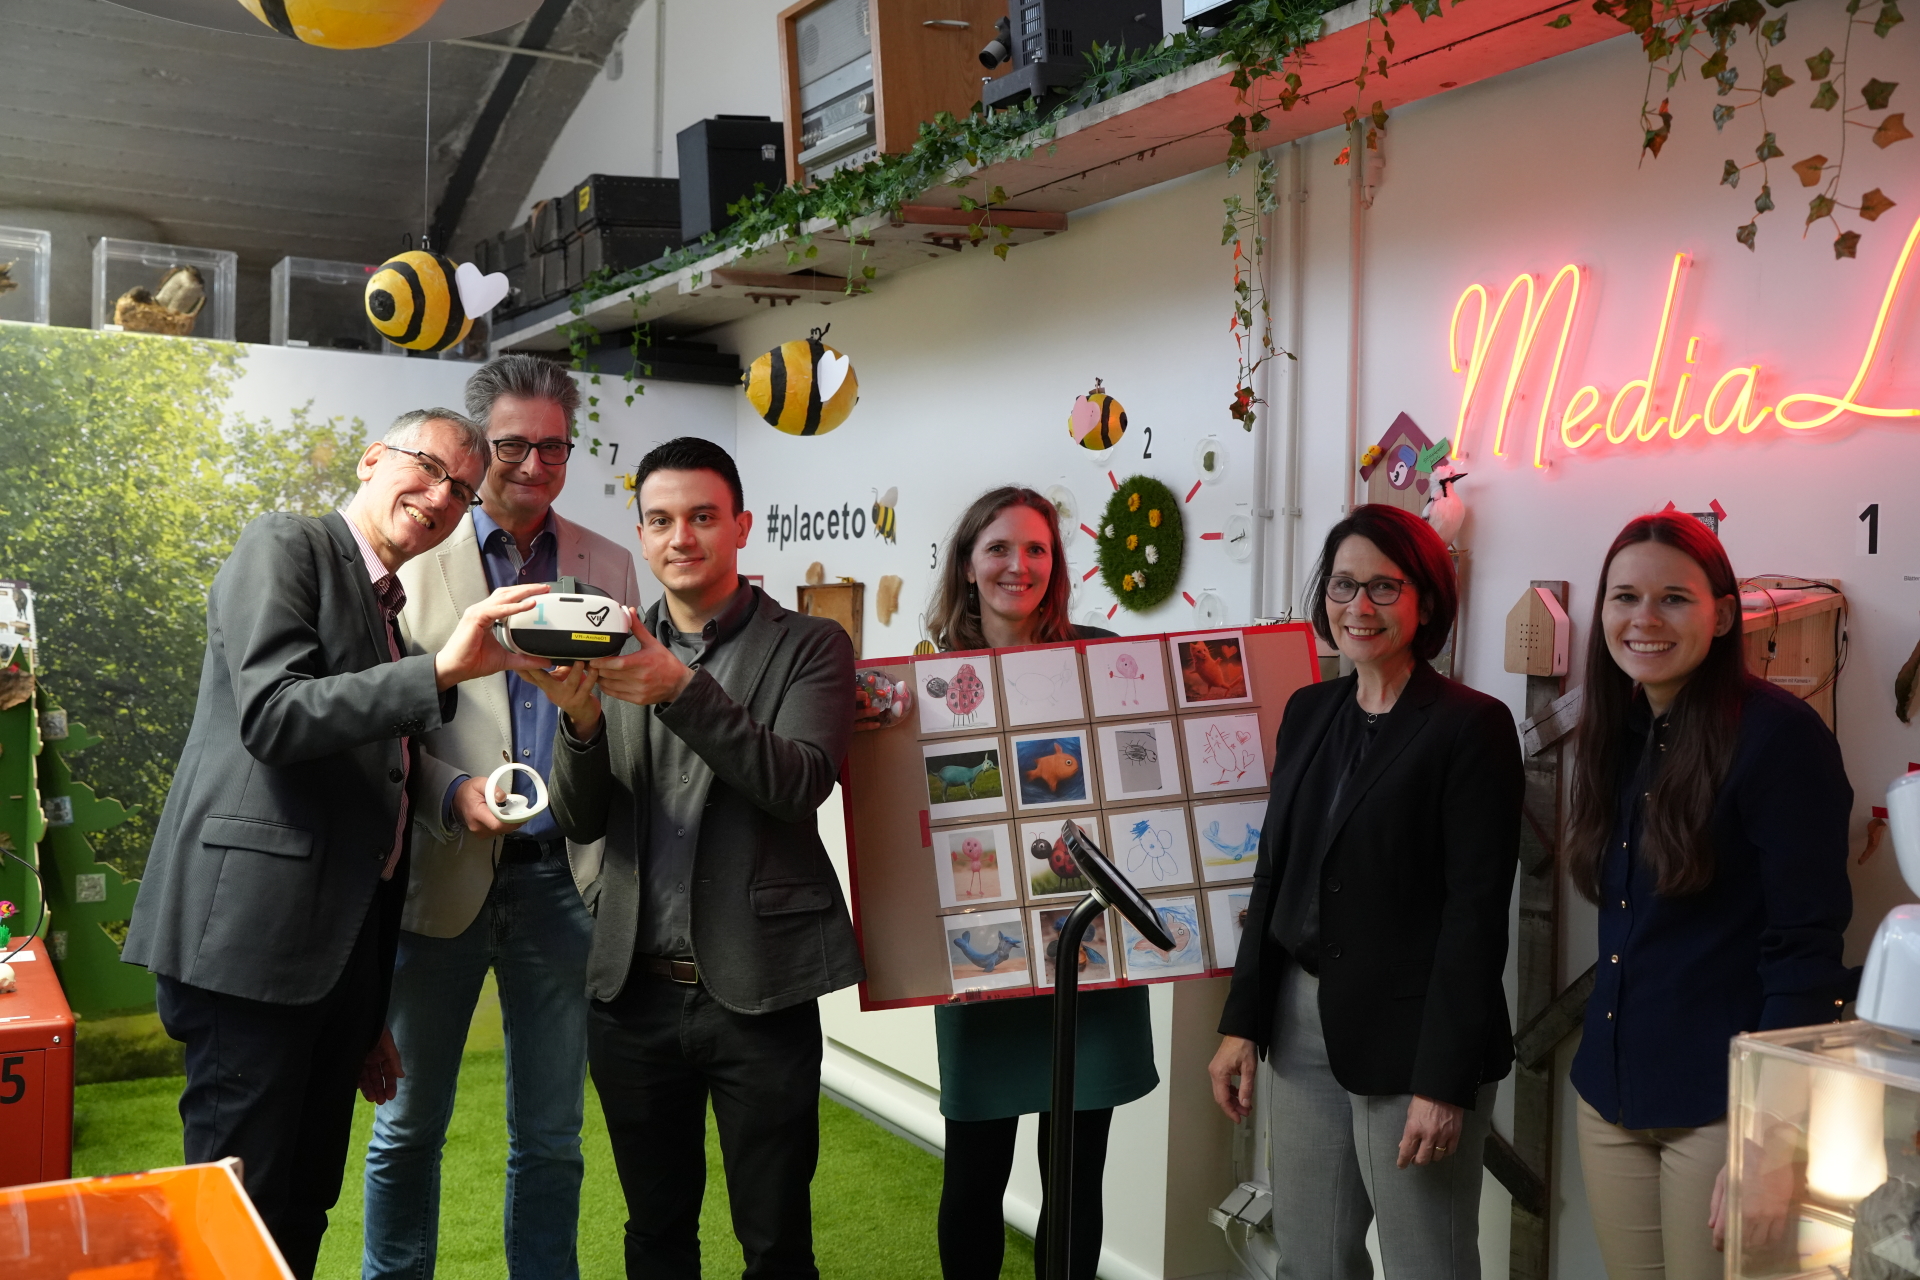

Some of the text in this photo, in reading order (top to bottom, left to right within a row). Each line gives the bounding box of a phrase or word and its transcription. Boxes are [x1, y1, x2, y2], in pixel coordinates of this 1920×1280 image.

[1450, 252, 1774, 468] Media
[609, 443, 619, 465] 7
[1143, 426, 1152, 459] 2
[767, 502, 866, 551] #placeto
[1859, 504, 1878, 554] 1
[930, 543, 937, 569] 3
[533, 603, 547, 625] 1
[0, 1056, 26, 1104] 5
